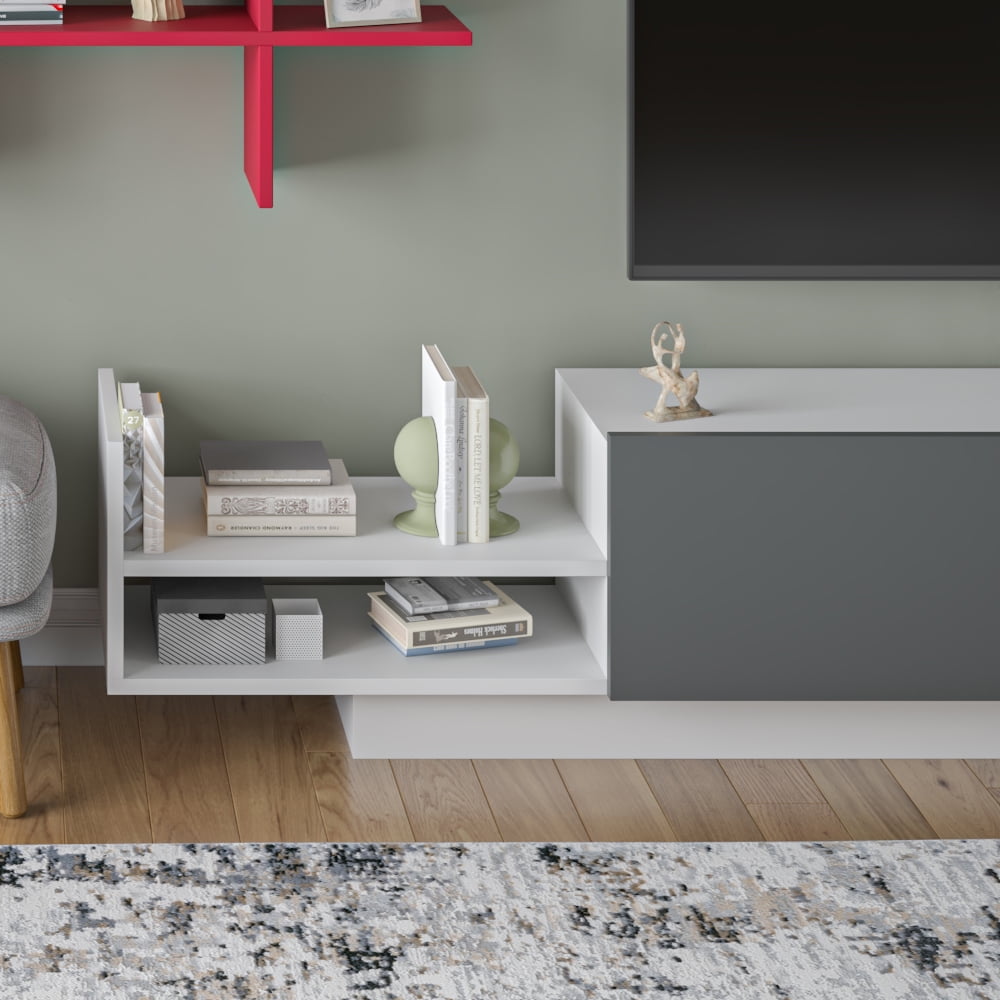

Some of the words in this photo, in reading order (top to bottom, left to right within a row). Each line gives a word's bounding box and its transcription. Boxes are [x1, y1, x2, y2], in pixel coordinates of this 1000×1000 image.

[127, 416, 140, 425] 27
[473, 457, 482, 472] LET
[473, 474, 482, 485] ME
[473, 486, 482, 505] LOVE
[463, 626, 483, 638] Holmes
[483, 624, 508, 636] Sherlock
